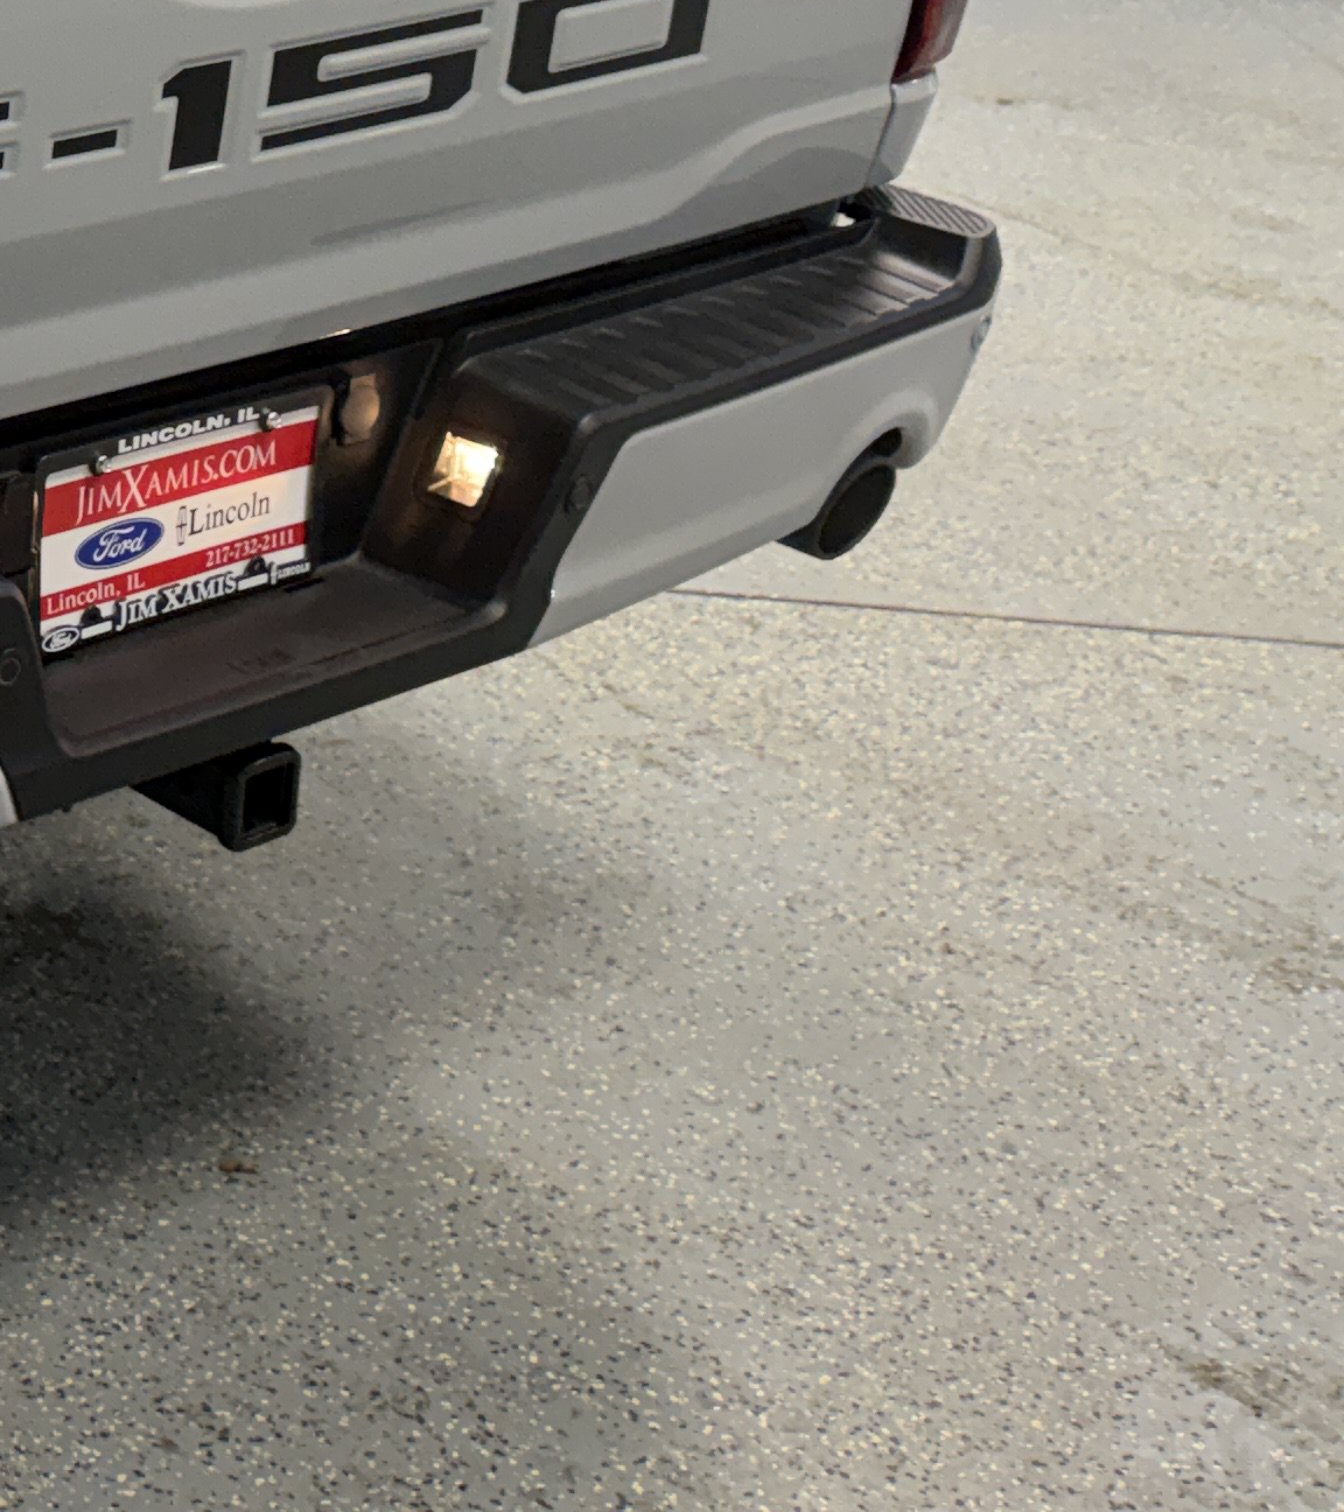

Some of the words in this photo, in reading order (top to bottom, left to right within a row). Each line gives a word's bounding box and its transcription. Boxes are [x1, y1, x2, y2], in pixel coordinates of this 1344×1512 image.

[237, 406, 260, 423] IL
[76, 440, 277, 526] JIMXAMIS.COM
[188, 492, 271, 536] Lincoln
[205, 528, 296, 569] 217-732-2111
[46, 580, 122, 615] Lincoln,
[127, 571, 146, 591] IL
[115, 595, 159, 632] JIM
[160, 570, 238, 614] XAMIS
